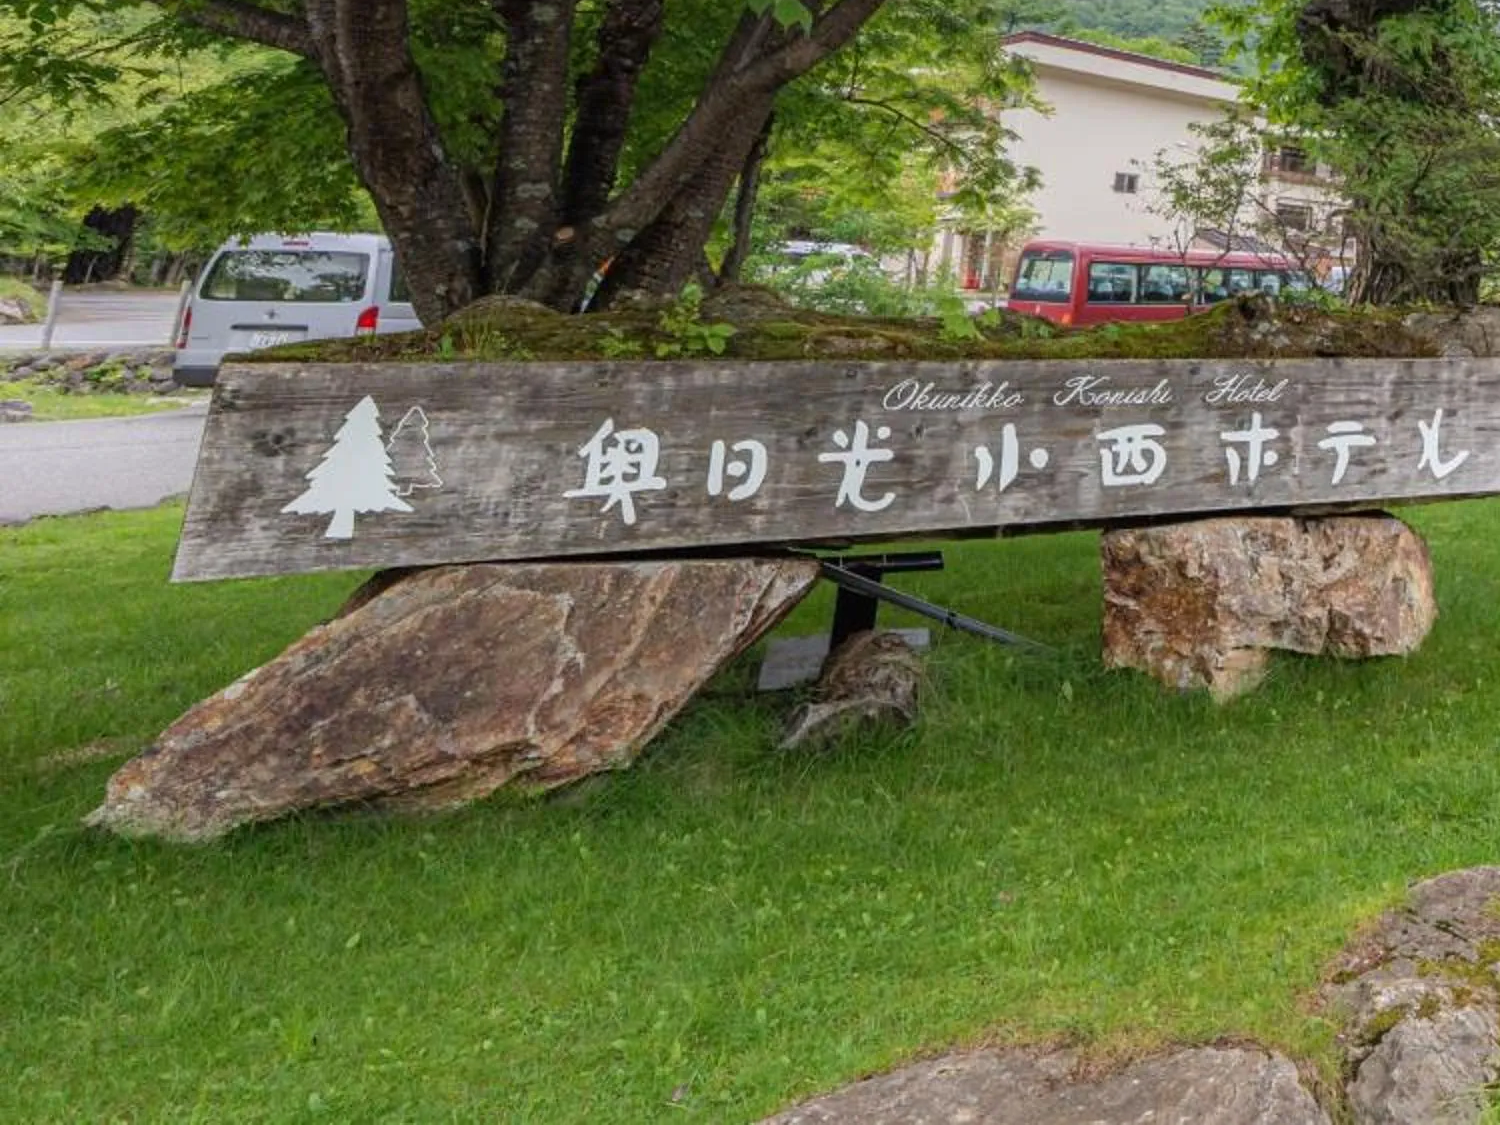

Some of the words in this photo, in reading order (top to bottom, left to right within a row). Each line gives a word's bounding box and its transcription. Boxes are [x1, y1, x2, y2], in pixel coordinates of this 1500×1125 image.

[882, 377, 1025, 412] Okunikko
[1053, 375, 1173, 407] Konishi
[1205, 373, 1290, 404] Hotel
[562, 407, 1470, 525] 奥日光小西ホテル
